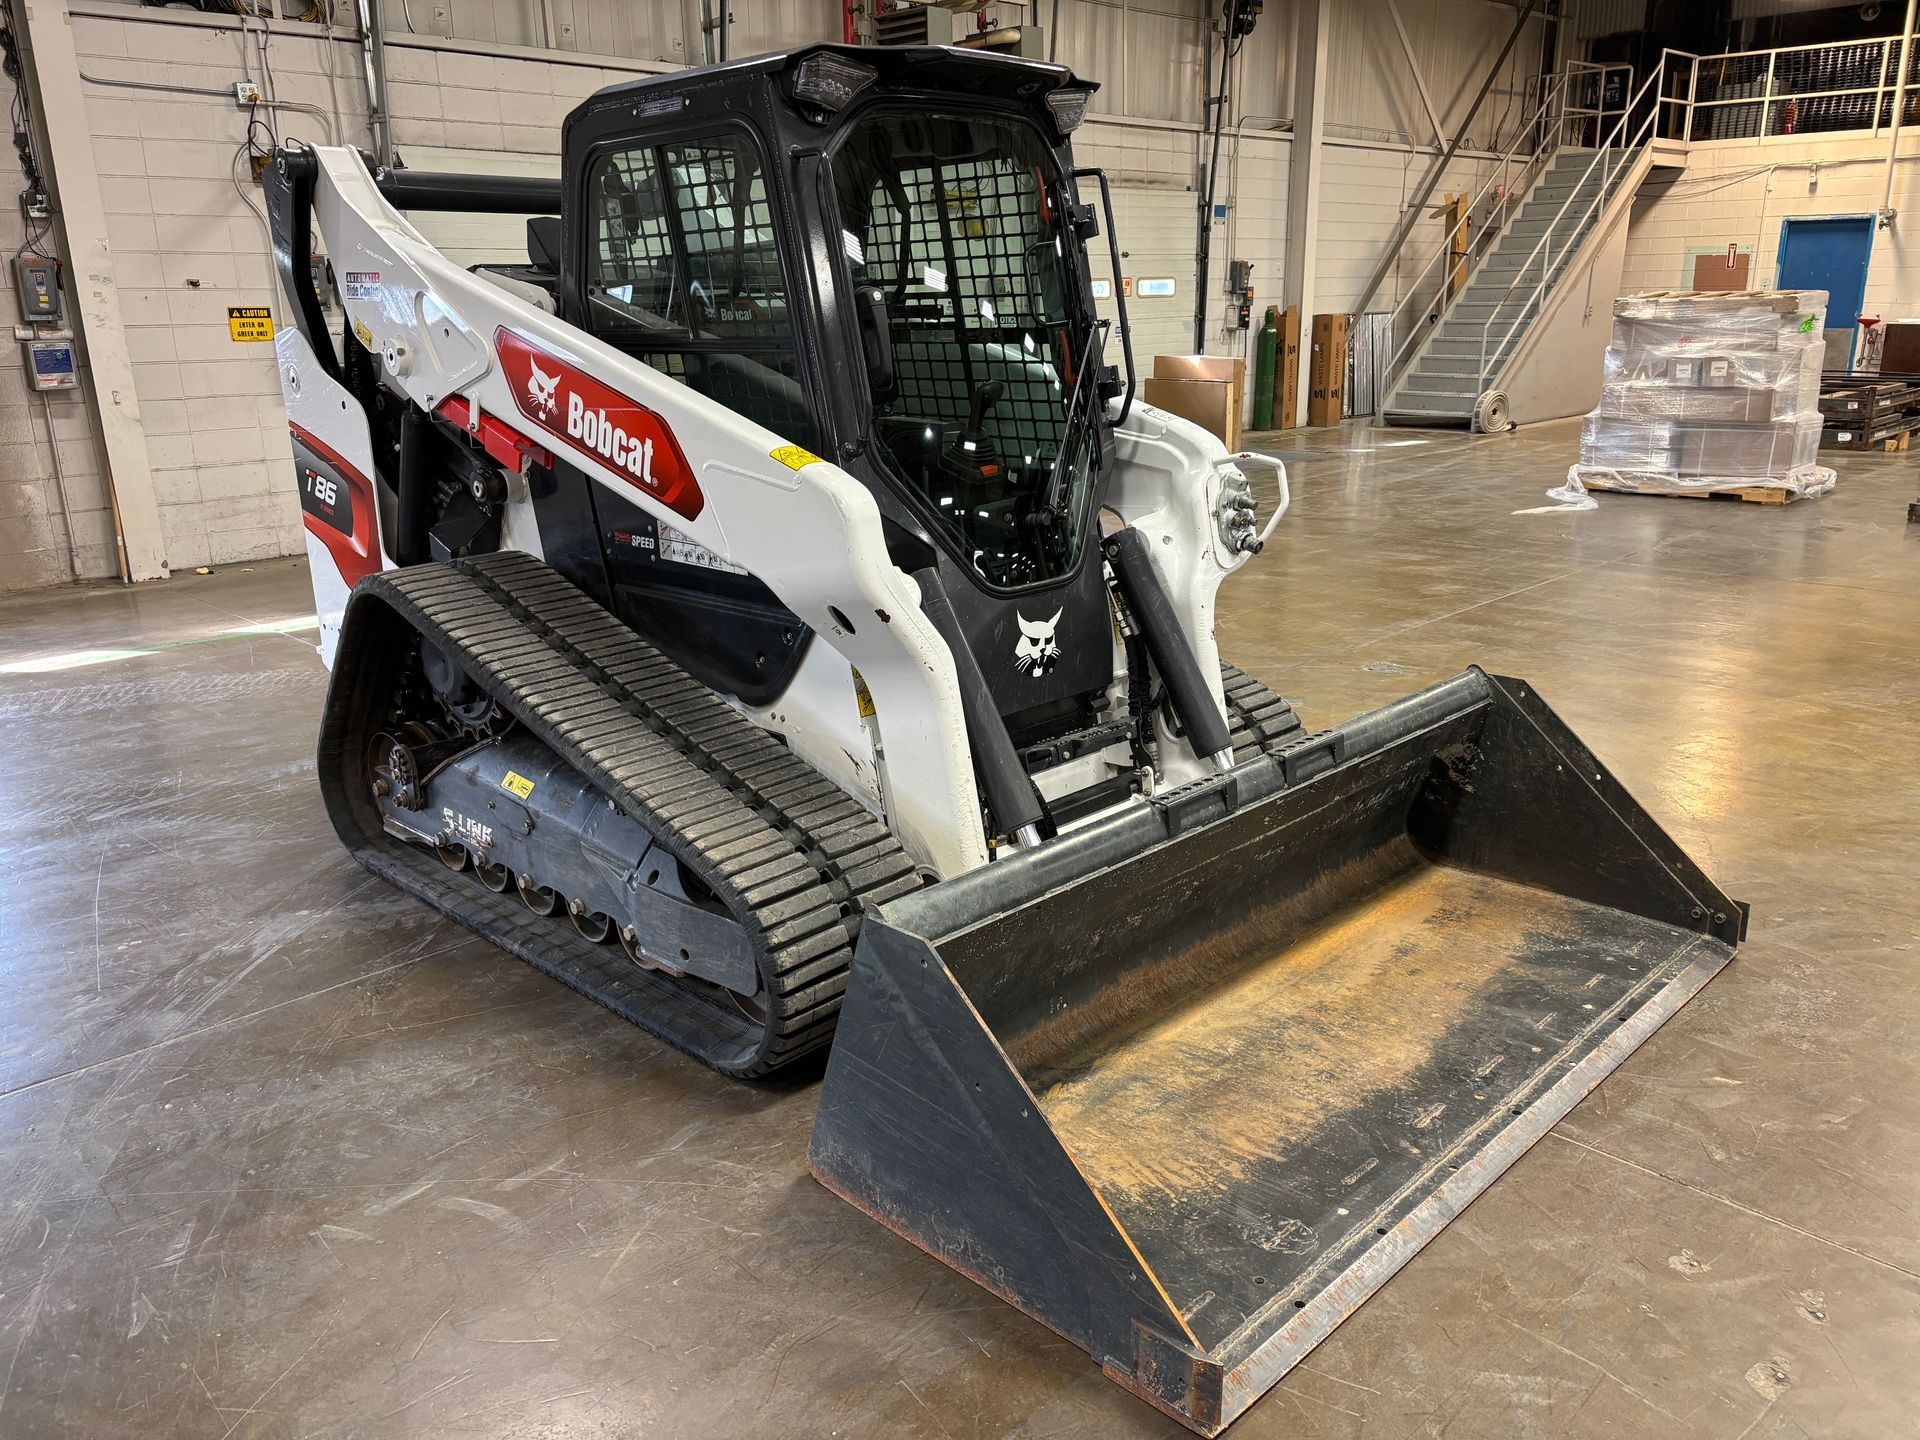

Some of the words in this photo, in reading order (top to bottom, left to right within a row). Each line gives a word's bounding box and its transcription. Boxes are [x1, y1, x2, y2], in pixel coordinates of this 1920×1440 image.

[346, 272, 380, 282] AUTOMATIC
[346, 284, 359, 297] Ride
[241, 309, 268, 317] CAUTION
[567, 390, 653, 484] Bobcat
[305, 468, 338, 506] T86
[631, 534, 655, 549] SPEED
